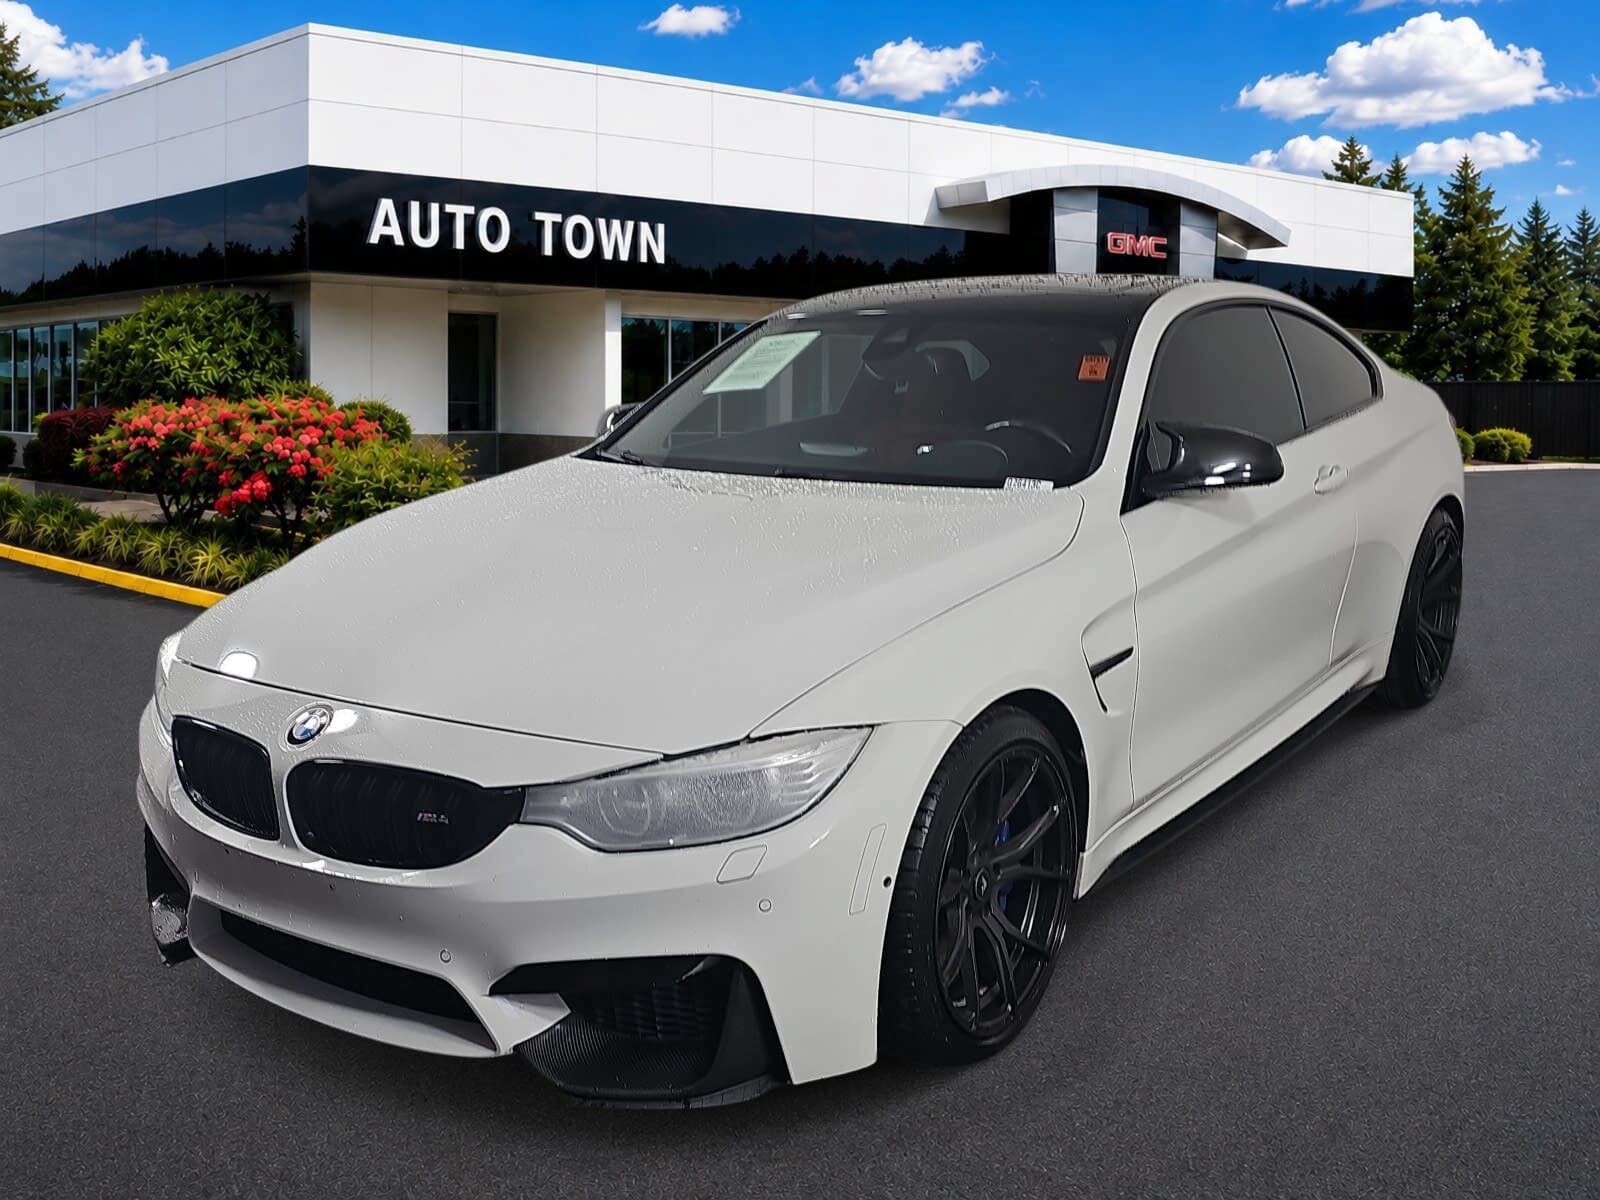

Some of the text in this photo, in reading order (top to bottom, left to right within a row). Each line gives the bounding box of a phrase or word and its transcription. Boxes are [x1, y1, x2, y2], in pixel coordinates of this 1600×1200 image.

[367, 197, 666, 264] AUTO TOWN
[1107, 232, 1167, 259] GMC
